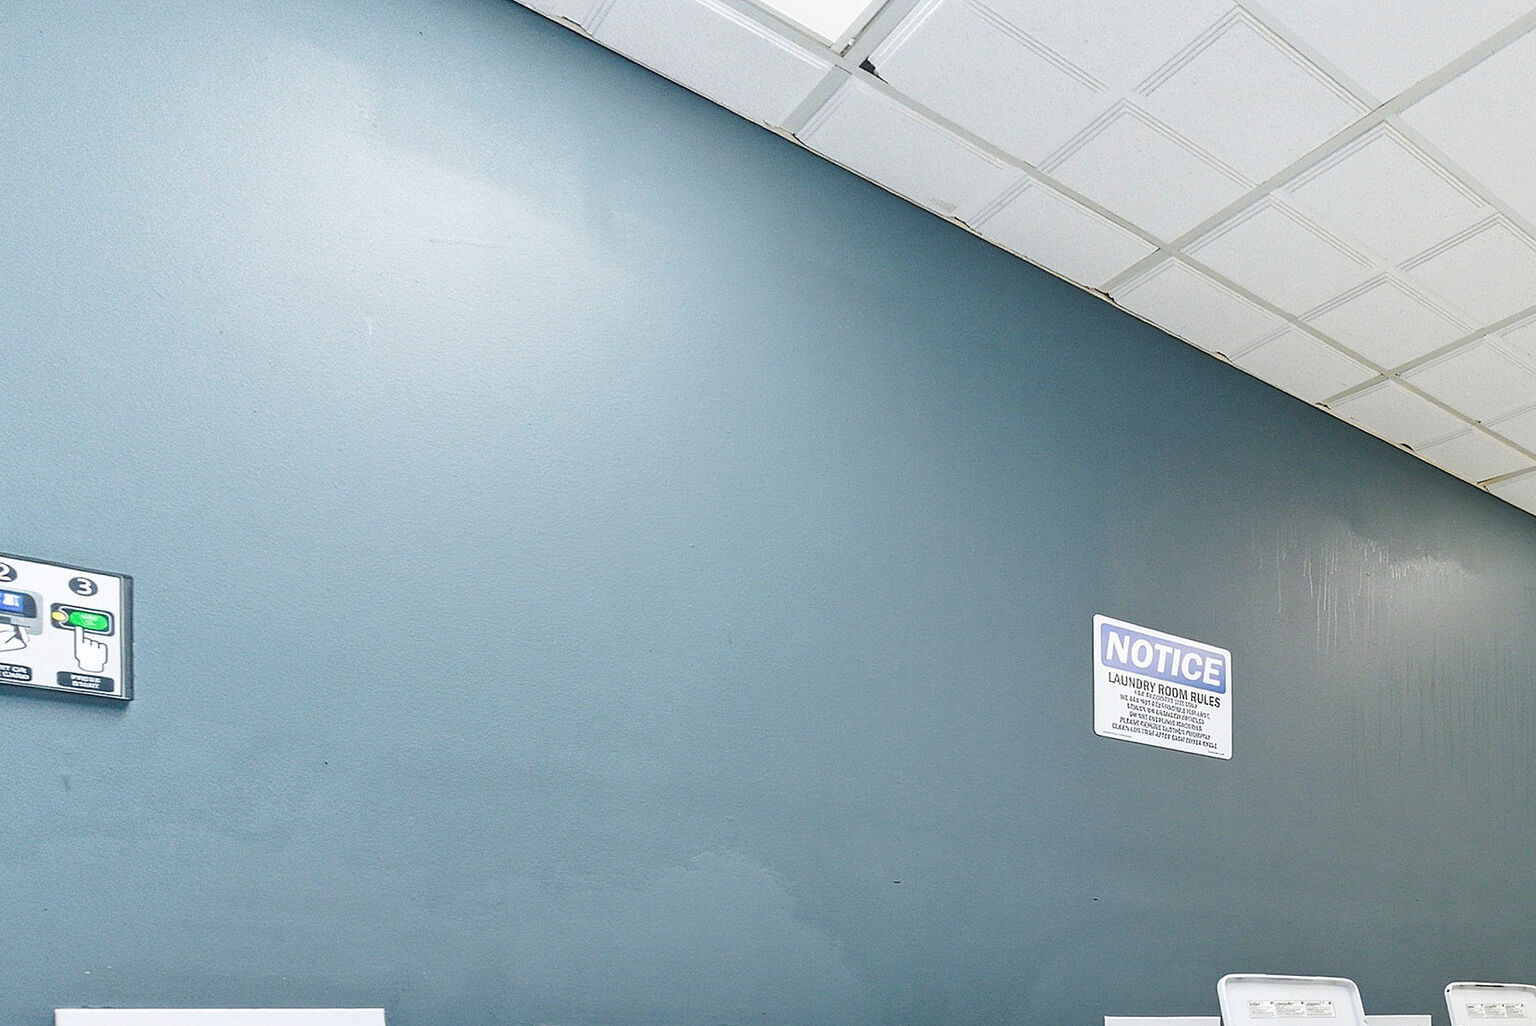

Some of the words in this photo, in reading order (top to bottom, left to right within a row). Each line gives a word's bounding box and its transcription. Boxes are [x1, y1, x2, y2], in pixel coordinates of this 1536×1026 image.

[76, 578, 92, 595] 3
[1106, 631, 1223, 686] NOTICE
[1108, 672, 1157, 693] LAUNDRY
[1158, 684, 1187, 701] ROOM
[1191, 692, 1221, 708] RULES
